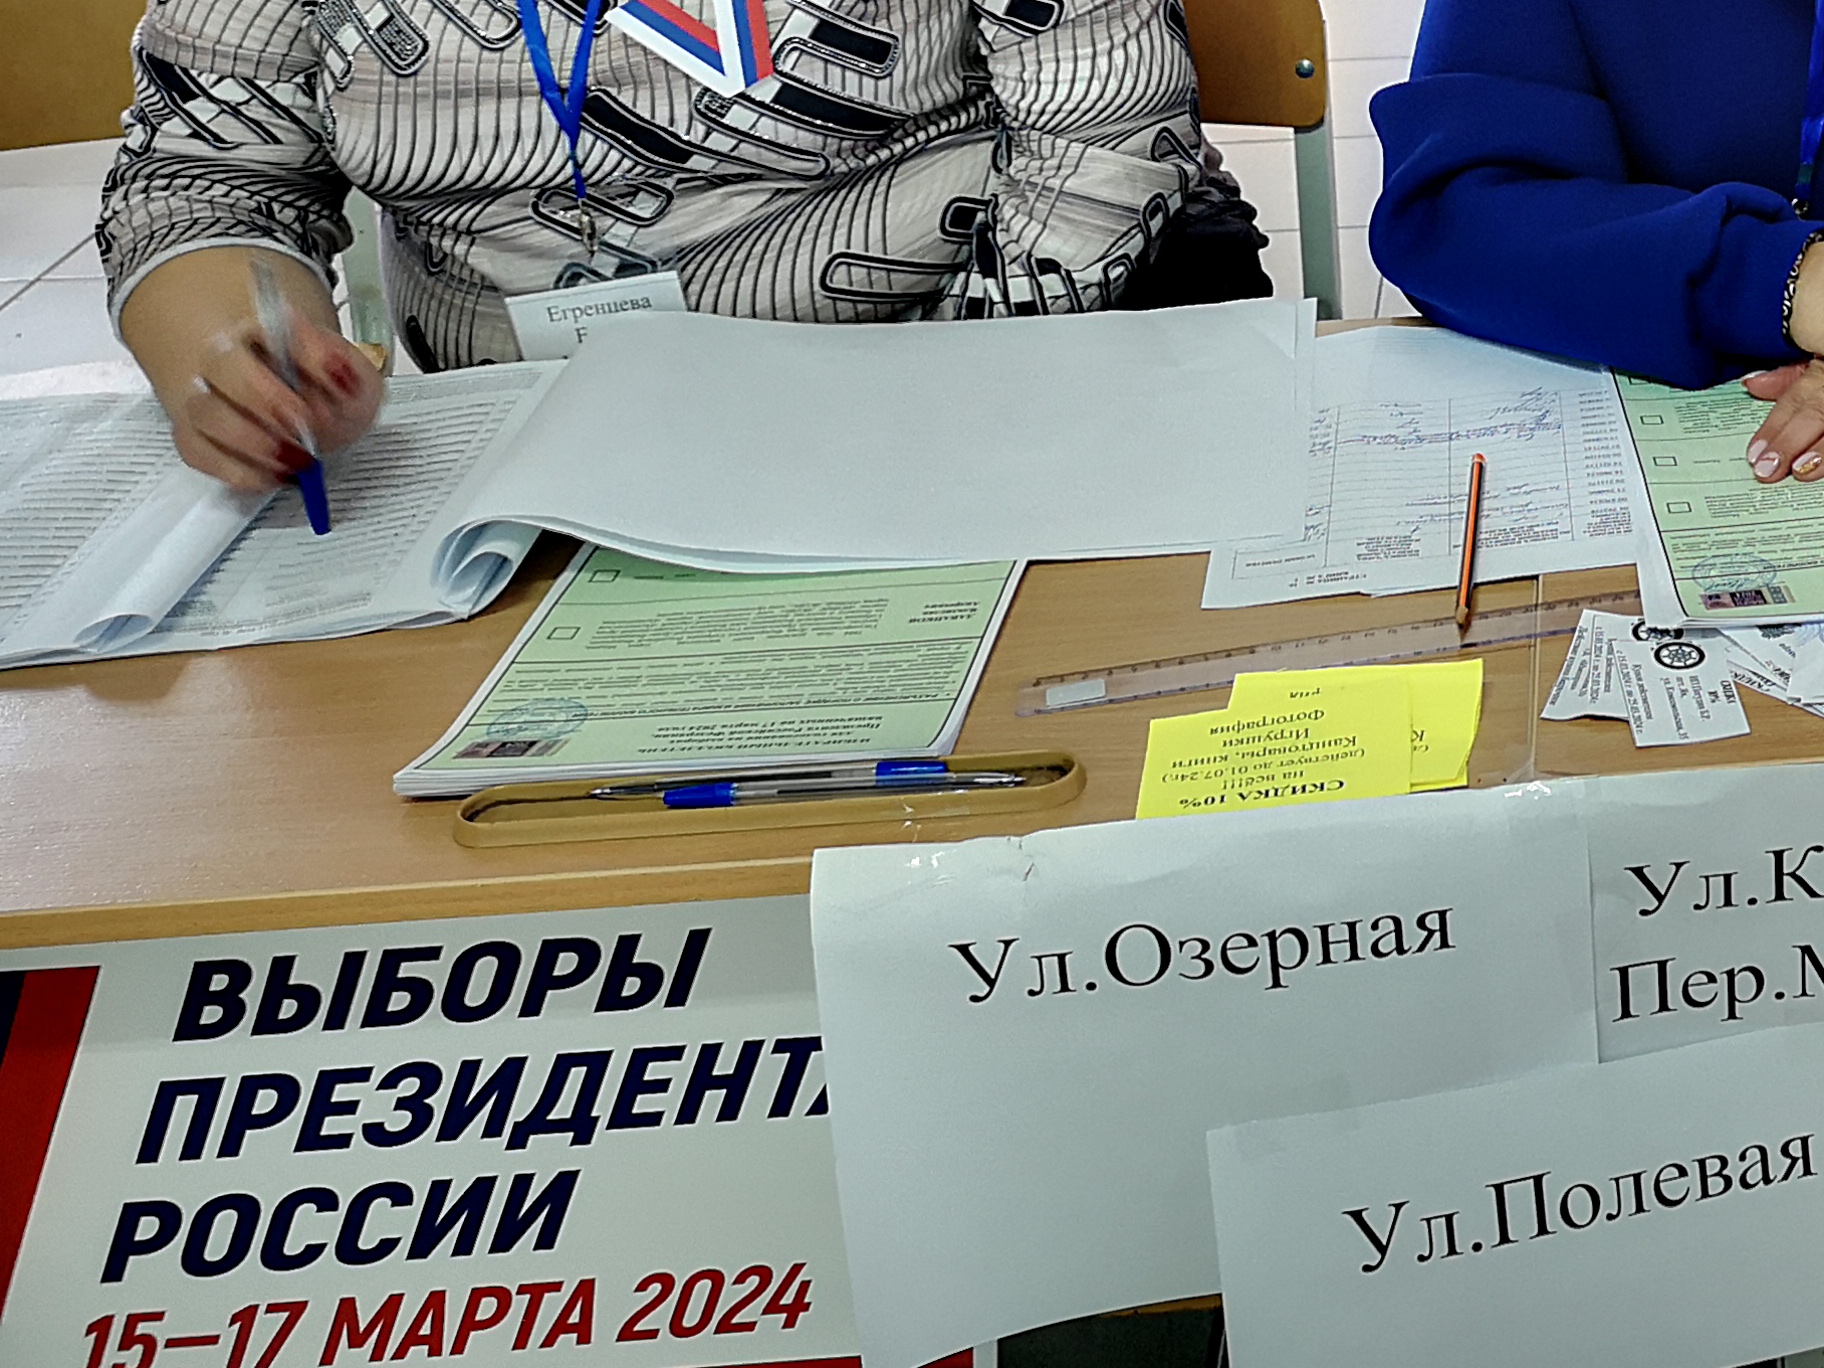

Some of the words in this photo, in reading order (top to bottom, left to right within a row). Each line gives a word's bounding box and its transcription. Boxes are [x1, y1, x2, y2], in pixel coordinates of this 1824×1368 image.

[1209, 710, 1324, 735] Фотография
[1222, 728, 1308, 748] Игрушки
[1235, 735, 1356, 759] Канцтовары,
[1171, 754, 1227, 768] книги
[1252, 762, 1271, 771] до
[1276, 748, 1364, 768] (действует
[1282, 769, 1304, 779] на
[1237, 780, 1345, 801] СКИДКА
[1179, 795, 1225, 809] 10%
[949, 907, 1456, 1003] Ул.Озерная
[172, 928, 713, 1042] ВЫБОРЫ
[1342, 1133, 1817, 1272] Ул.Полевая
[100, 1169, 582, 1283] РОССИИ
[319, 1277, 597, 1366] МАРТА
[616, 1262, 812, 1343] 2024
